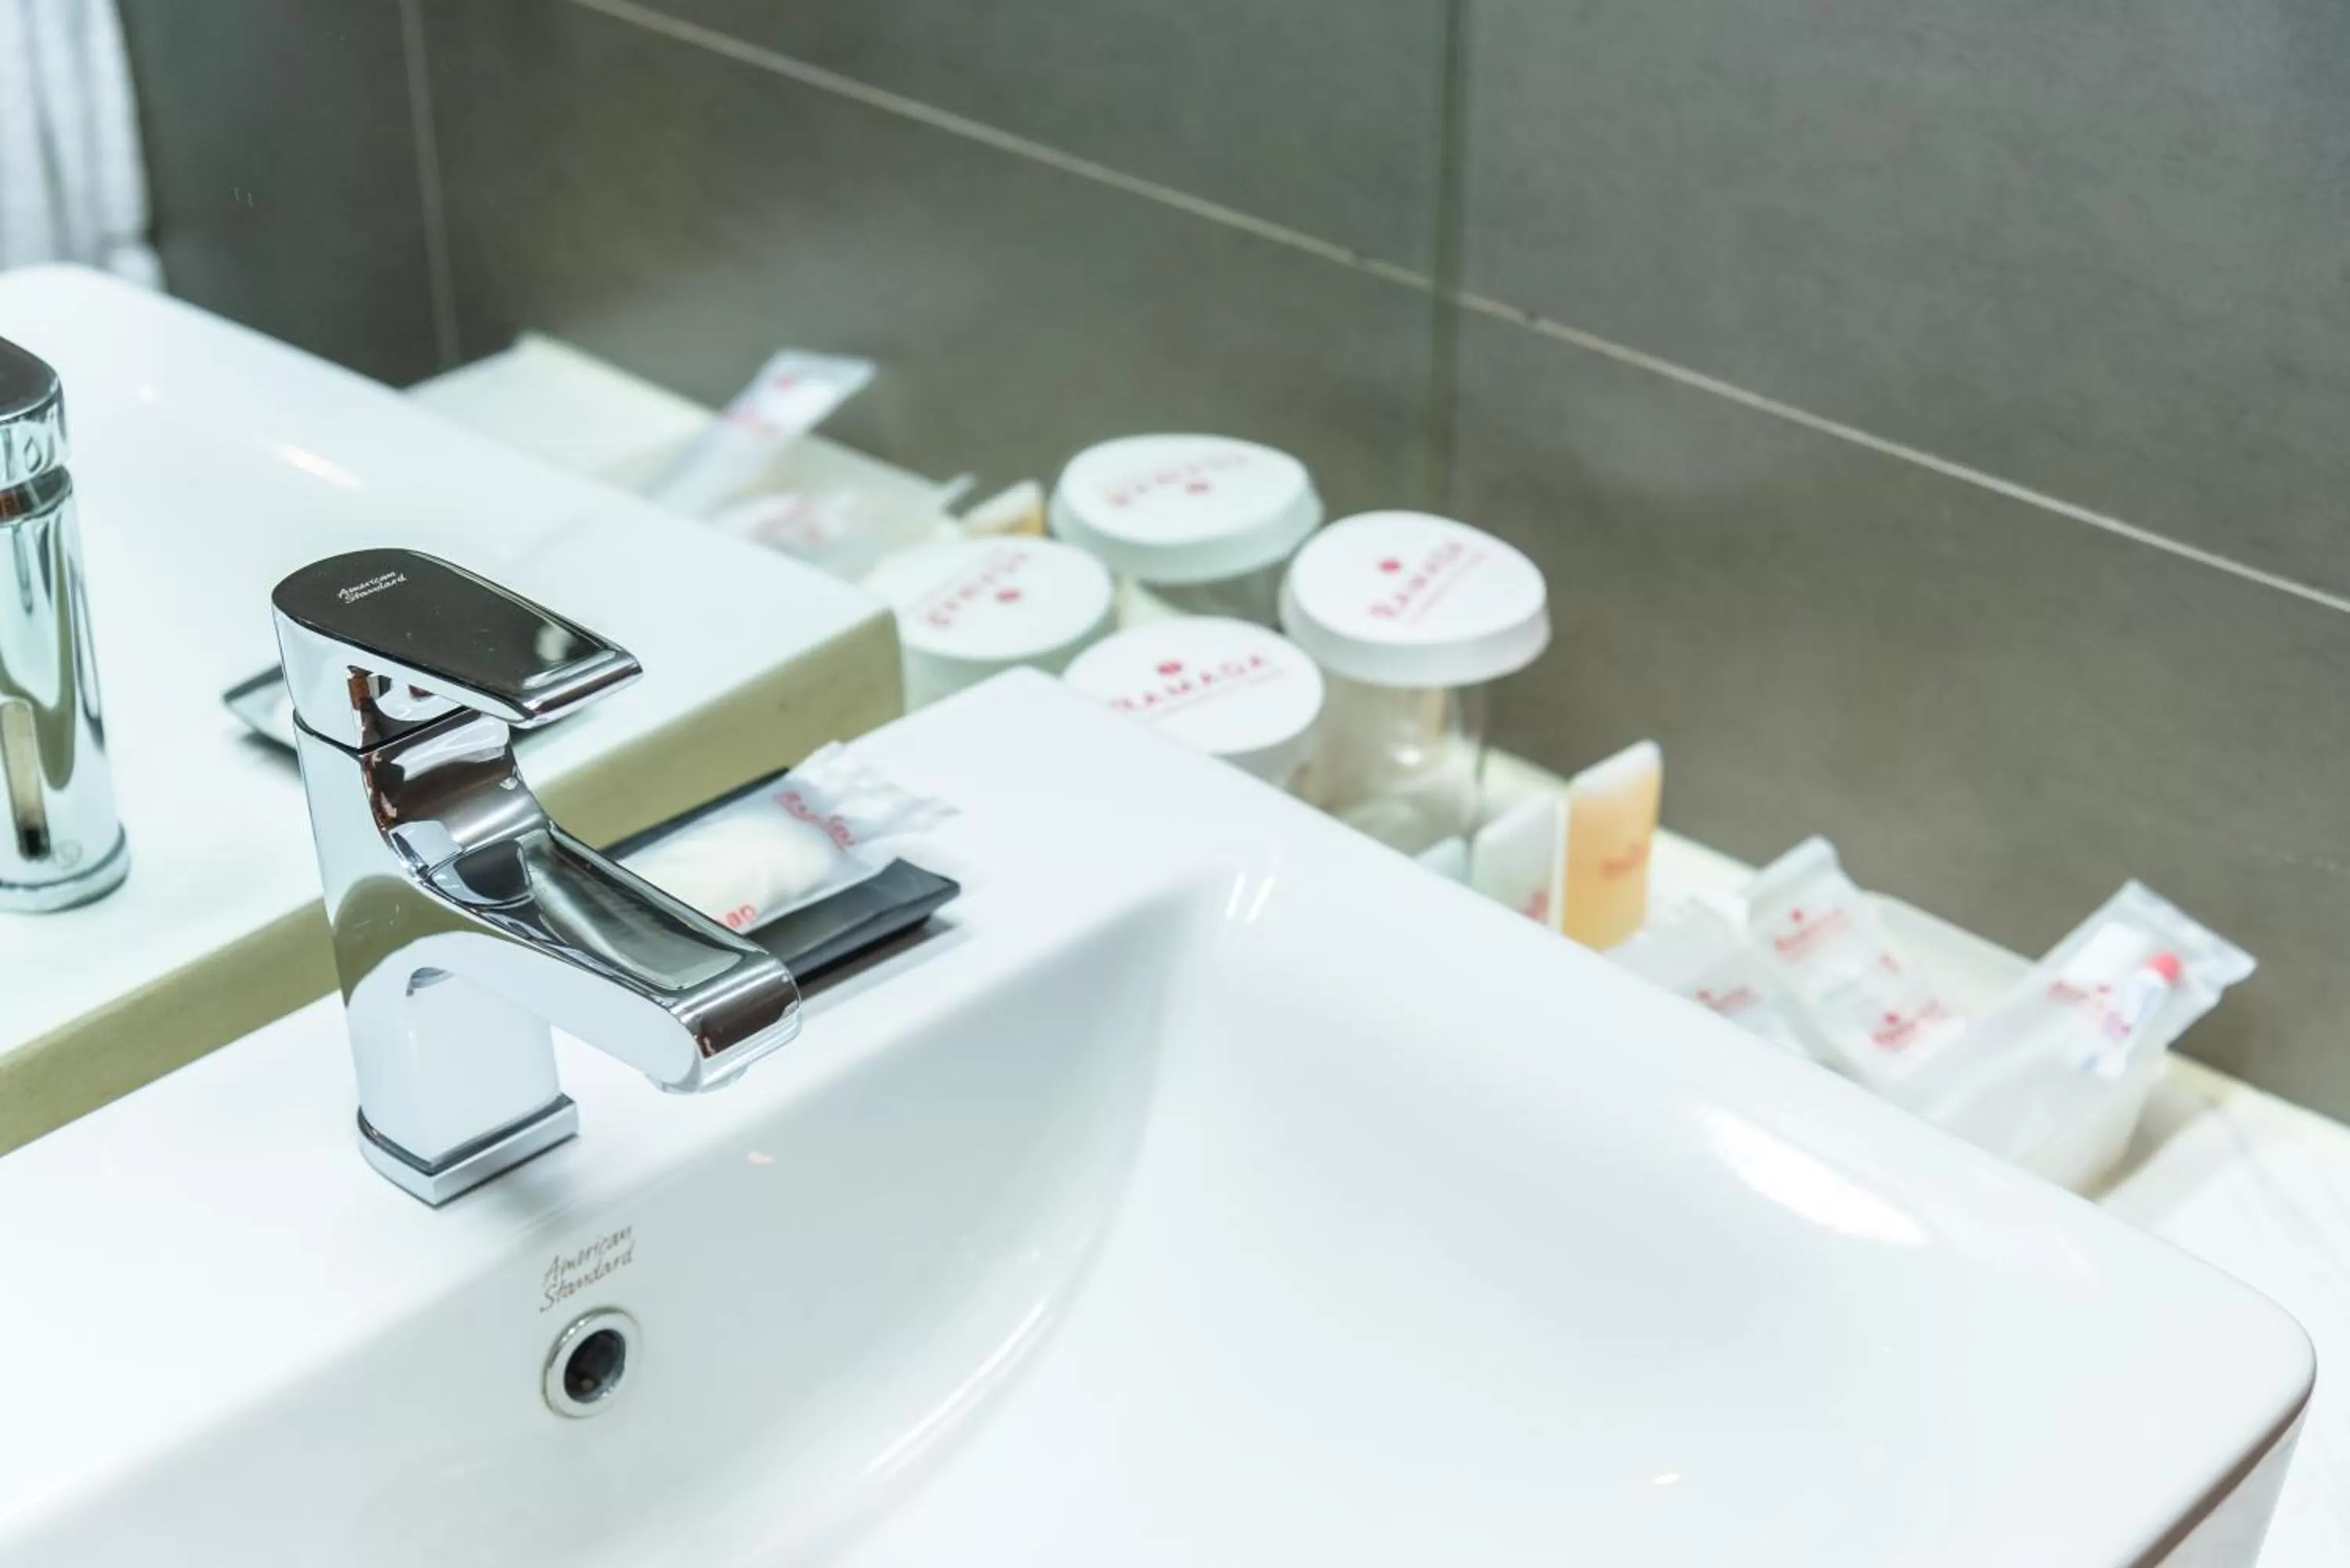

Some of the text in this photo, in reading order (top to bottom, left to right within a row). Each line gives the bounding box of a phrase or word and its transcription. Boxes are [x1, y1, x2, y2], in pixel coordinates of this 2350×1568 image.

[338, 571, 396, 598] American
[345, 573, 407, 604] Standard
[539, 1239, 636, 1314] Standard
[541, 1225, 632, 1288] American
